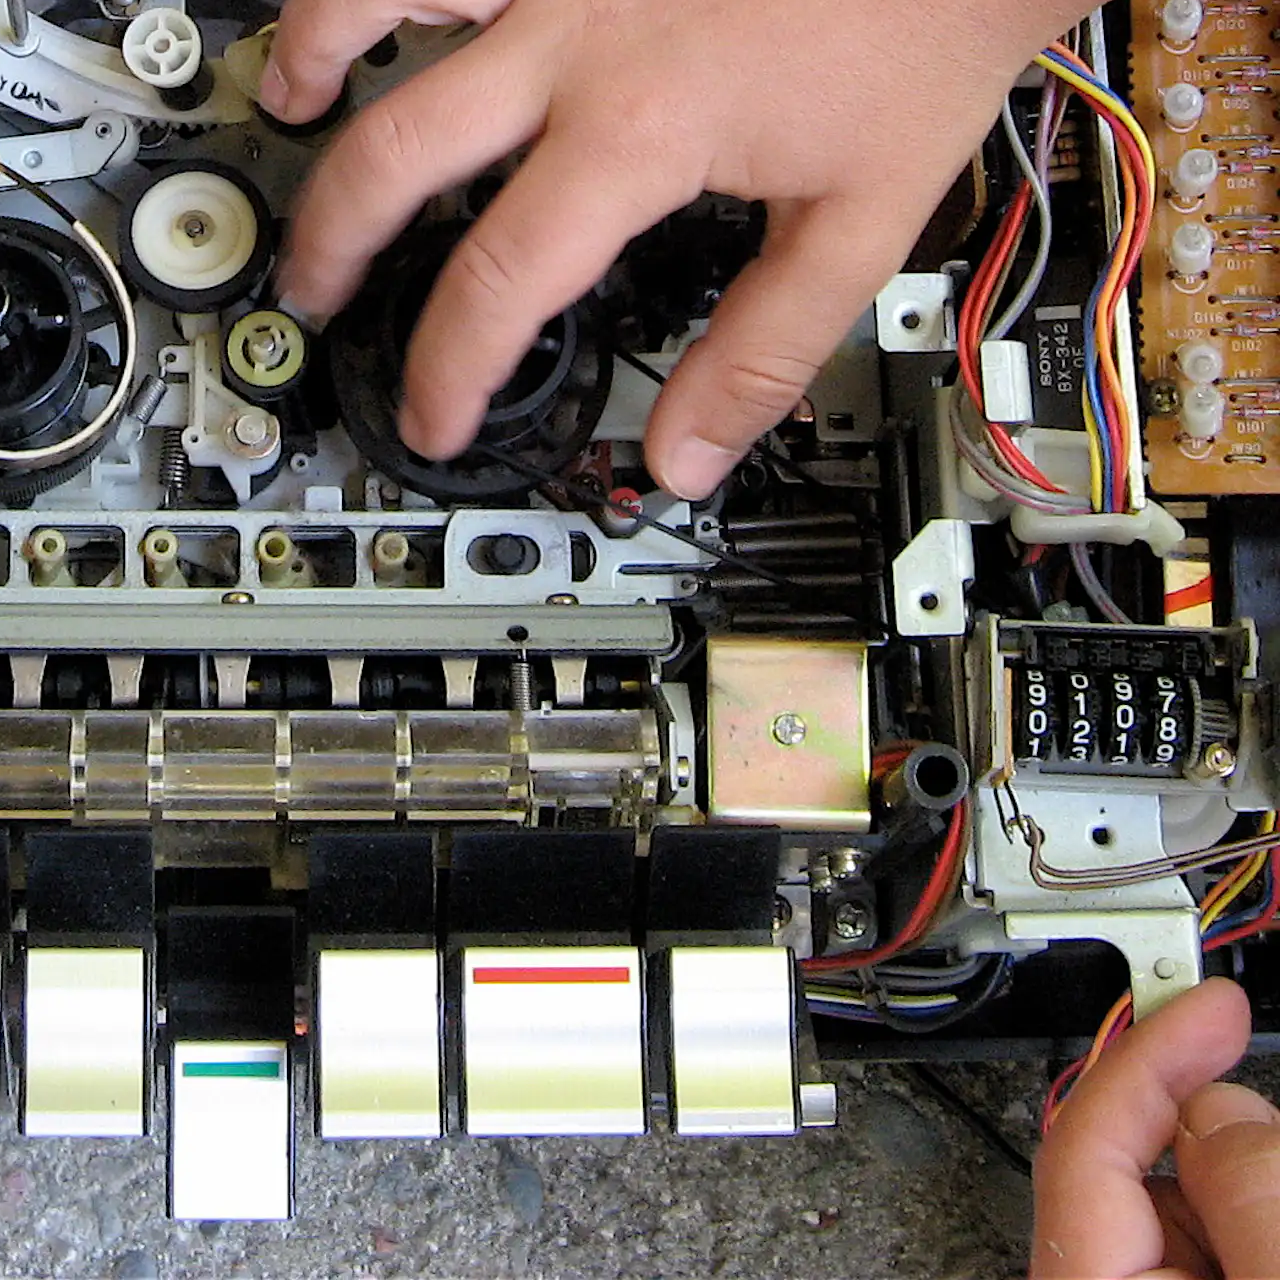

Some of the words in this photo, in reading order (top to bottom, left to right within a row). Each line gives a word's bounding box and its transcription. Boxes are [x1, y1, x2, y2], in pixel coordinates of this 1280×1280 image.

[1037, 332, 1053, 387] SONY
[1053, 323, 1073, 392] BX-342
[1236, 422, 1266, 434] D101
